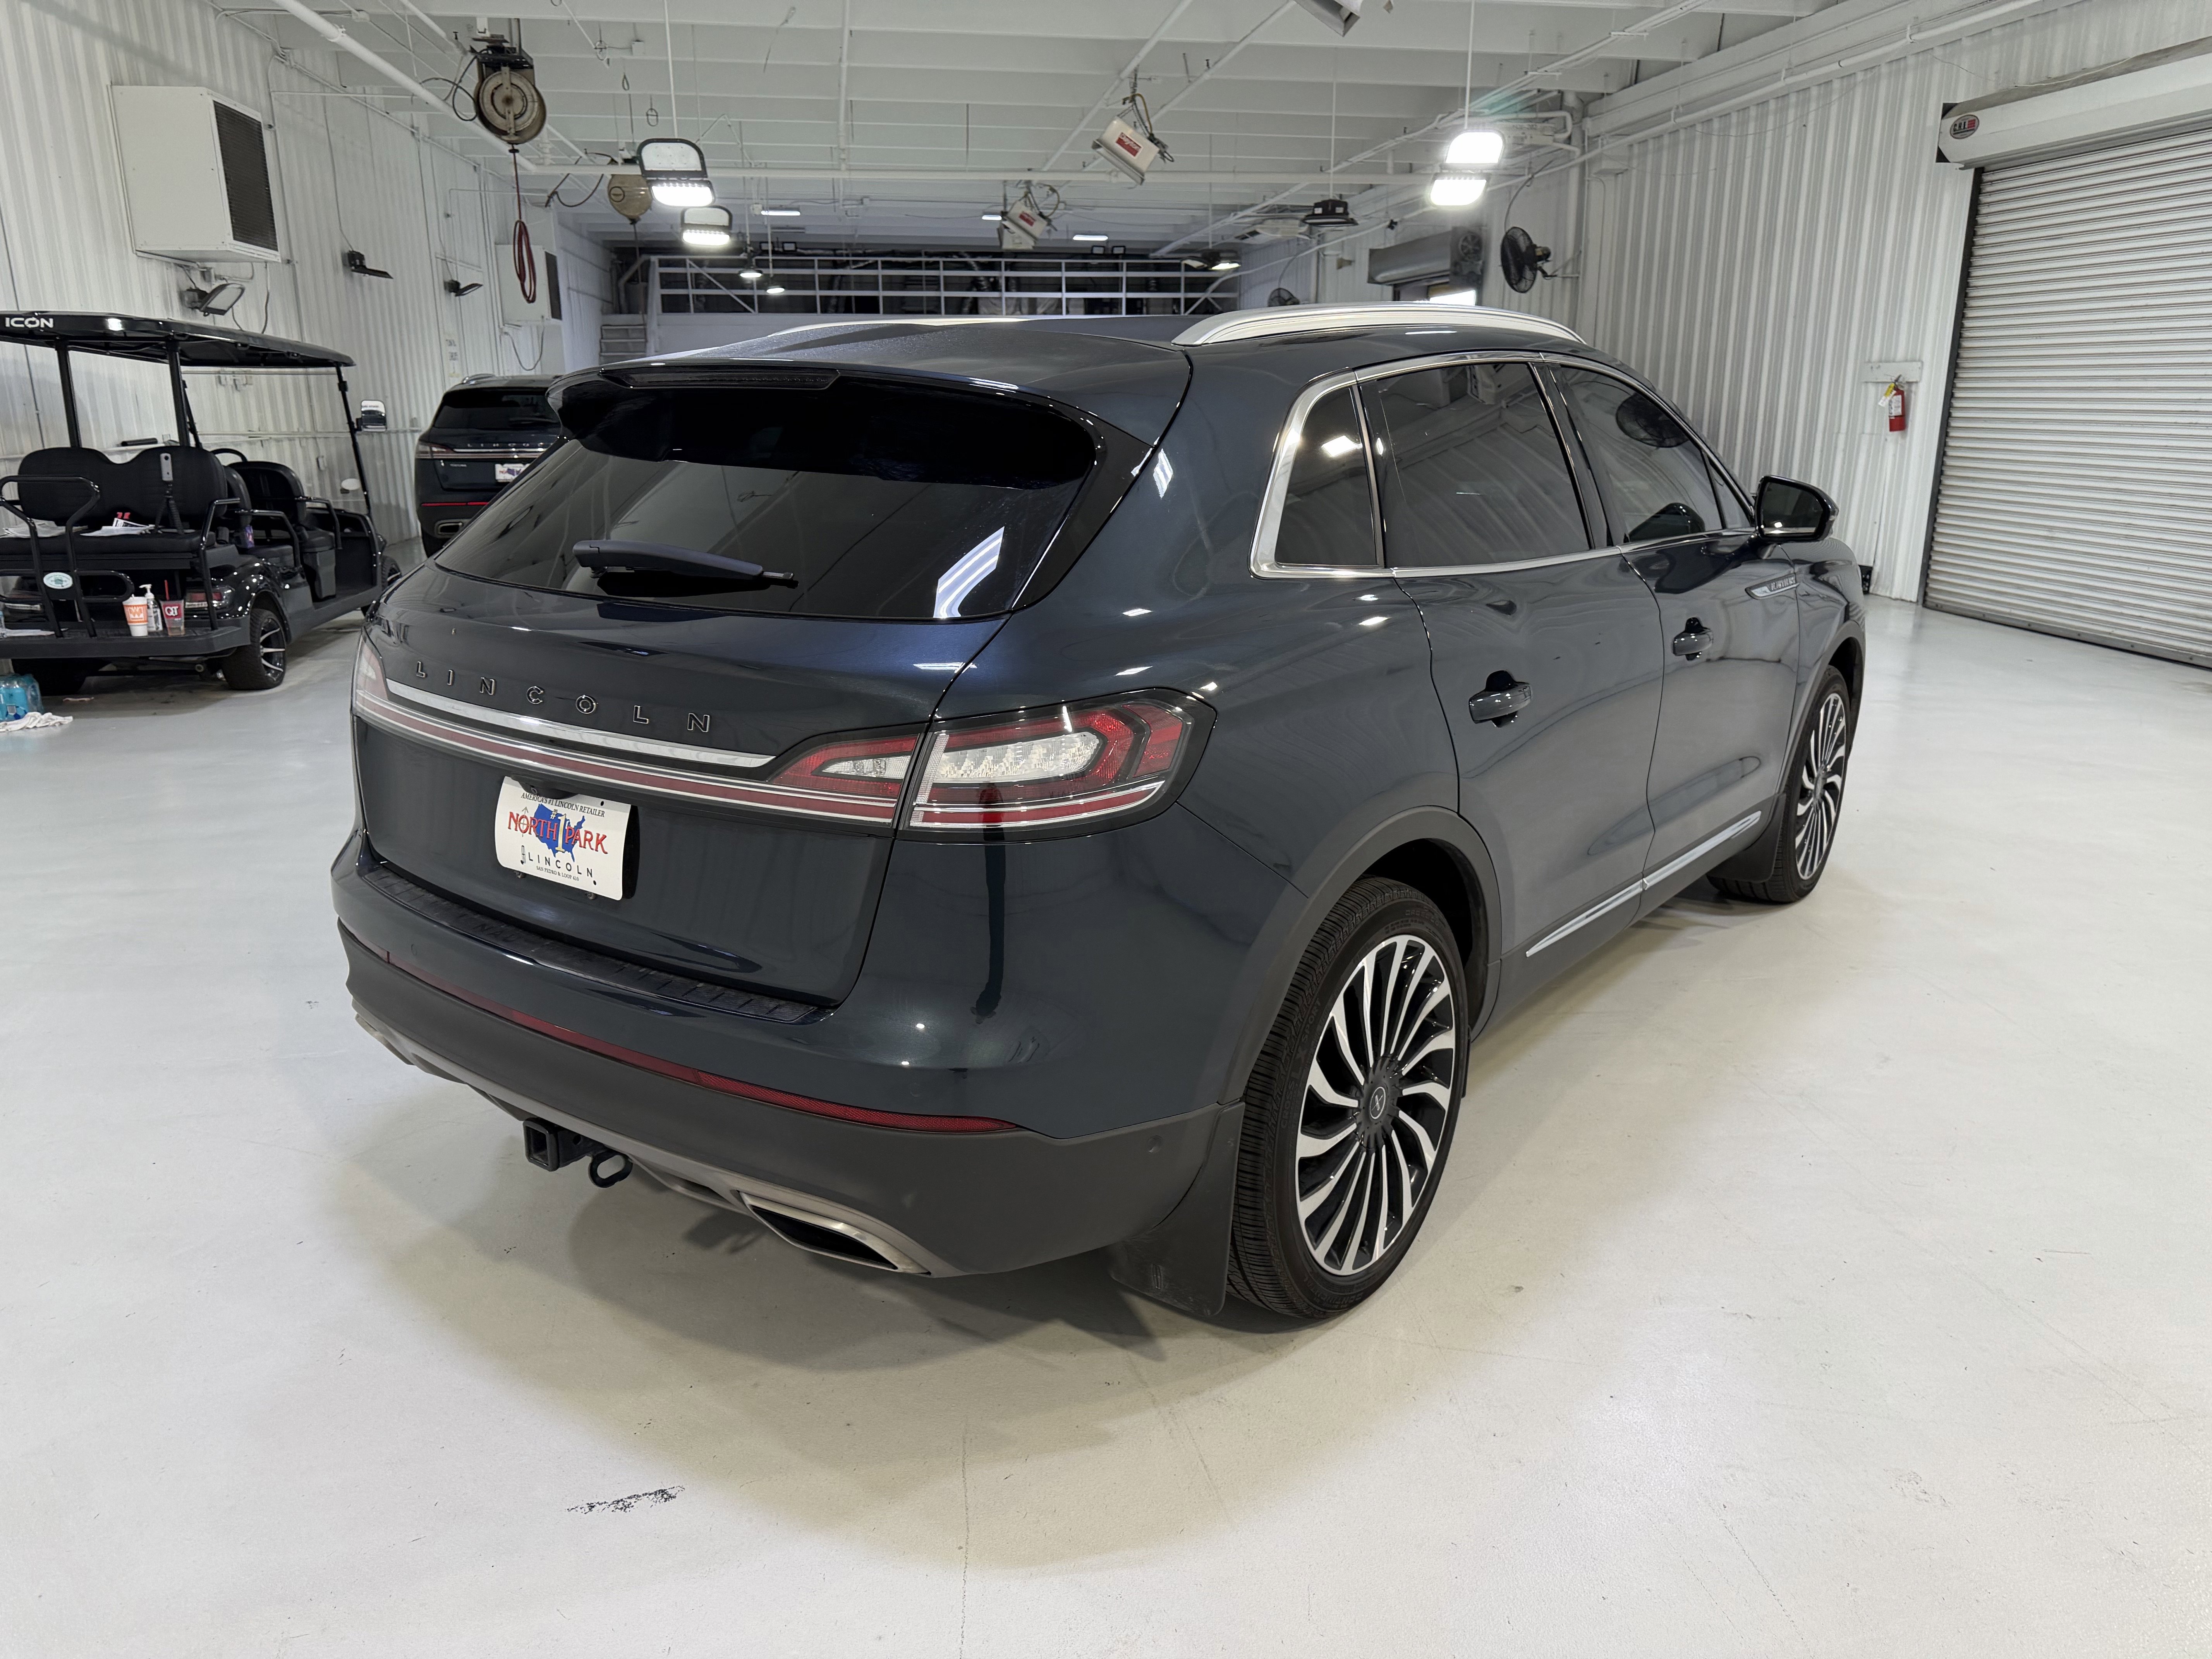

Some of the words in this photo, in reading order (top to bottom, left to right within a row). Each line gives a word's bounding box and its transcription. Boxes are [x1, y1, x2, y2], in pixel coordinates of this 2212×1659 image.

[5, 317, 53, 328] ICON
[165, 606, 179, 616] QT
[416, 660, 711, 733] LINCOLN
[555, 800, 579, 811] LINCOLN
[579, 806, 605, 817] RETAILER
[508, 811, 558, 840] NORTH
[564, 826, 608, 854] PARK
[528, 852, 593, 878] LINCOLN
[1280, 1080, 1296, 1128] CROSS
[1291, 1044, 1307, 1079] LX
[1301, 997, 1321, 1043] SPORT
